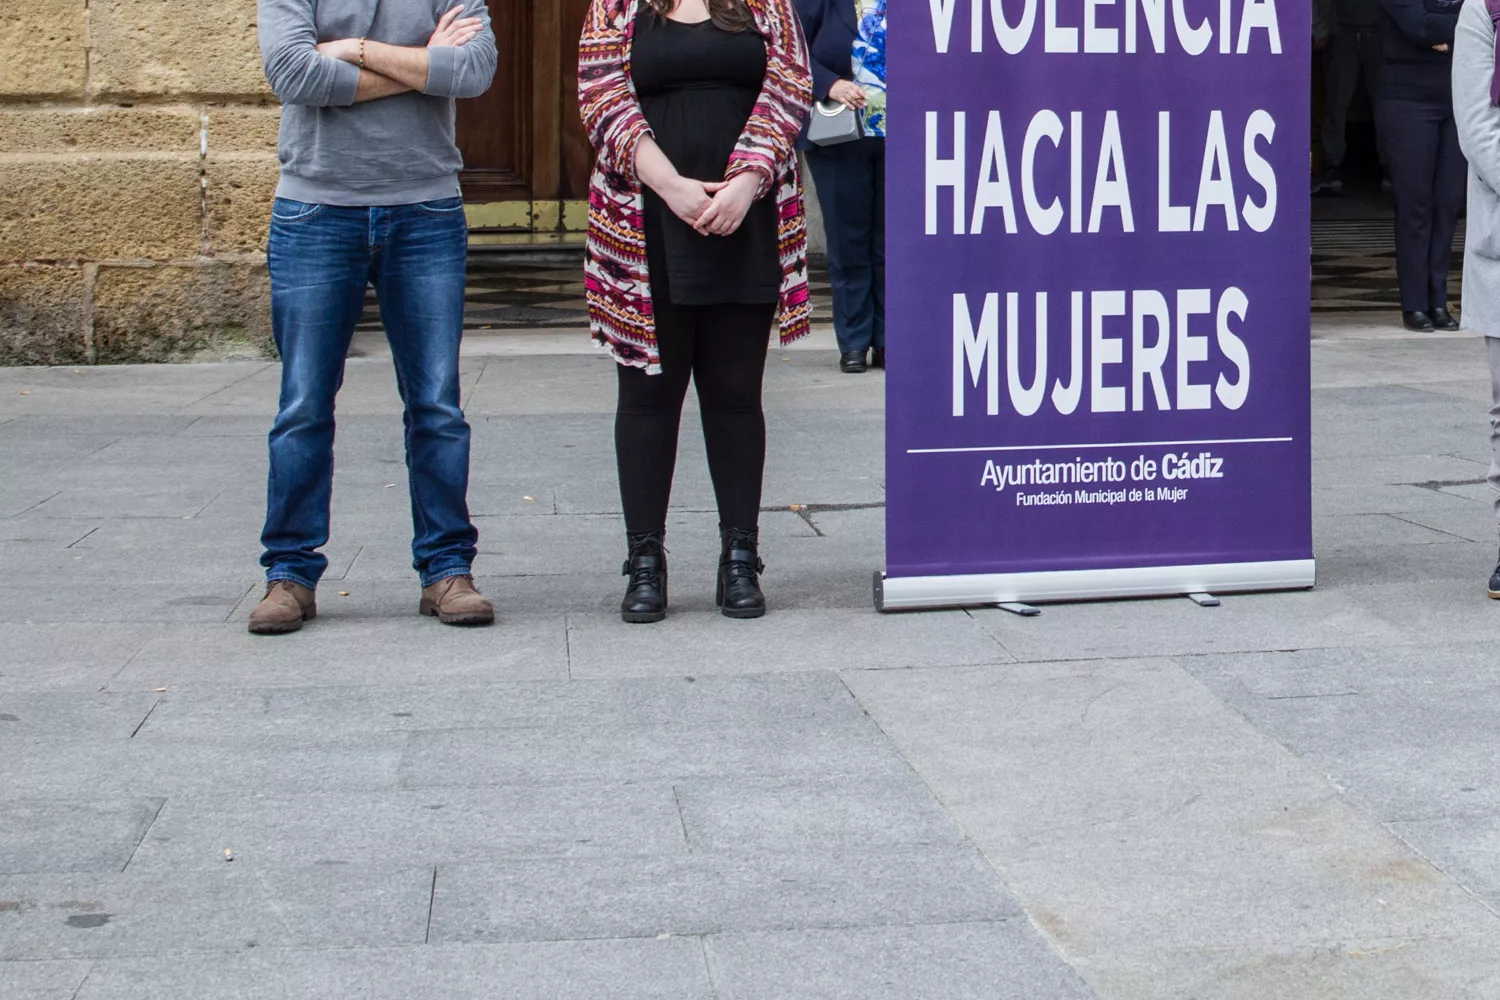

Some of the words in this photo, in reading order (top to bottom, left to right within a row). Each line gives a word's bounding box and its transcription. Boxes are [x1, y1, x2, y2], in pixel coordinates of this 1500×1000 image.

[924, 109, 1135, 236] HACIA
[1158, 109, 1279, 233] LAS
[952, 286, 1251, 417] MUJERES
[980, 457, 1127, 492] Ayuntamiento
[1130, 454, 1158, 482] de
[1162, 451, 1224, 480] Cádiz
[1016, 489, 1072, 506] Fundación
[1074, 488, 1127, 506] Municipal
[1129, 487, 1143, 502] de
[1144, 487, 1155, 502] la
[1156, 486, 1190, 504] Mujer
